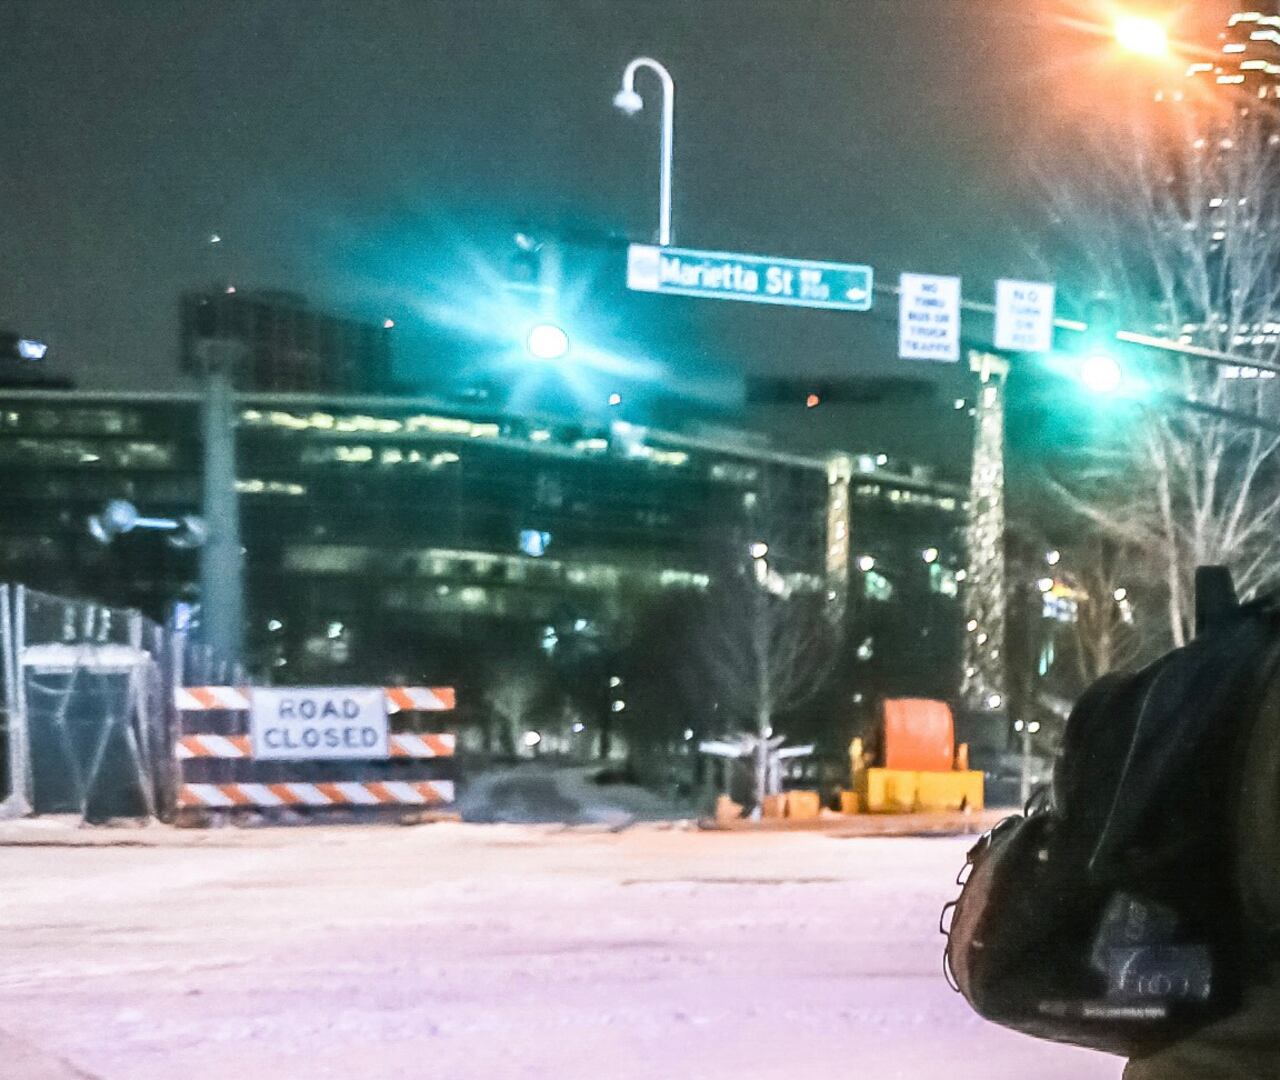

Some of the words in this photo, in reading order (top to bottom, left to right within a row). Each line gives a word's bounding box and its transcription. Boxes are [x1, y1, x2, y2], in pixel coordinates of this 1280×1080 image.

[660, 256, 758, 293] Marietta
[766, 266, 793, 296] St
[279, 698, 361, 720] ROAD
[263, 727, 378, 749] CLOSED
